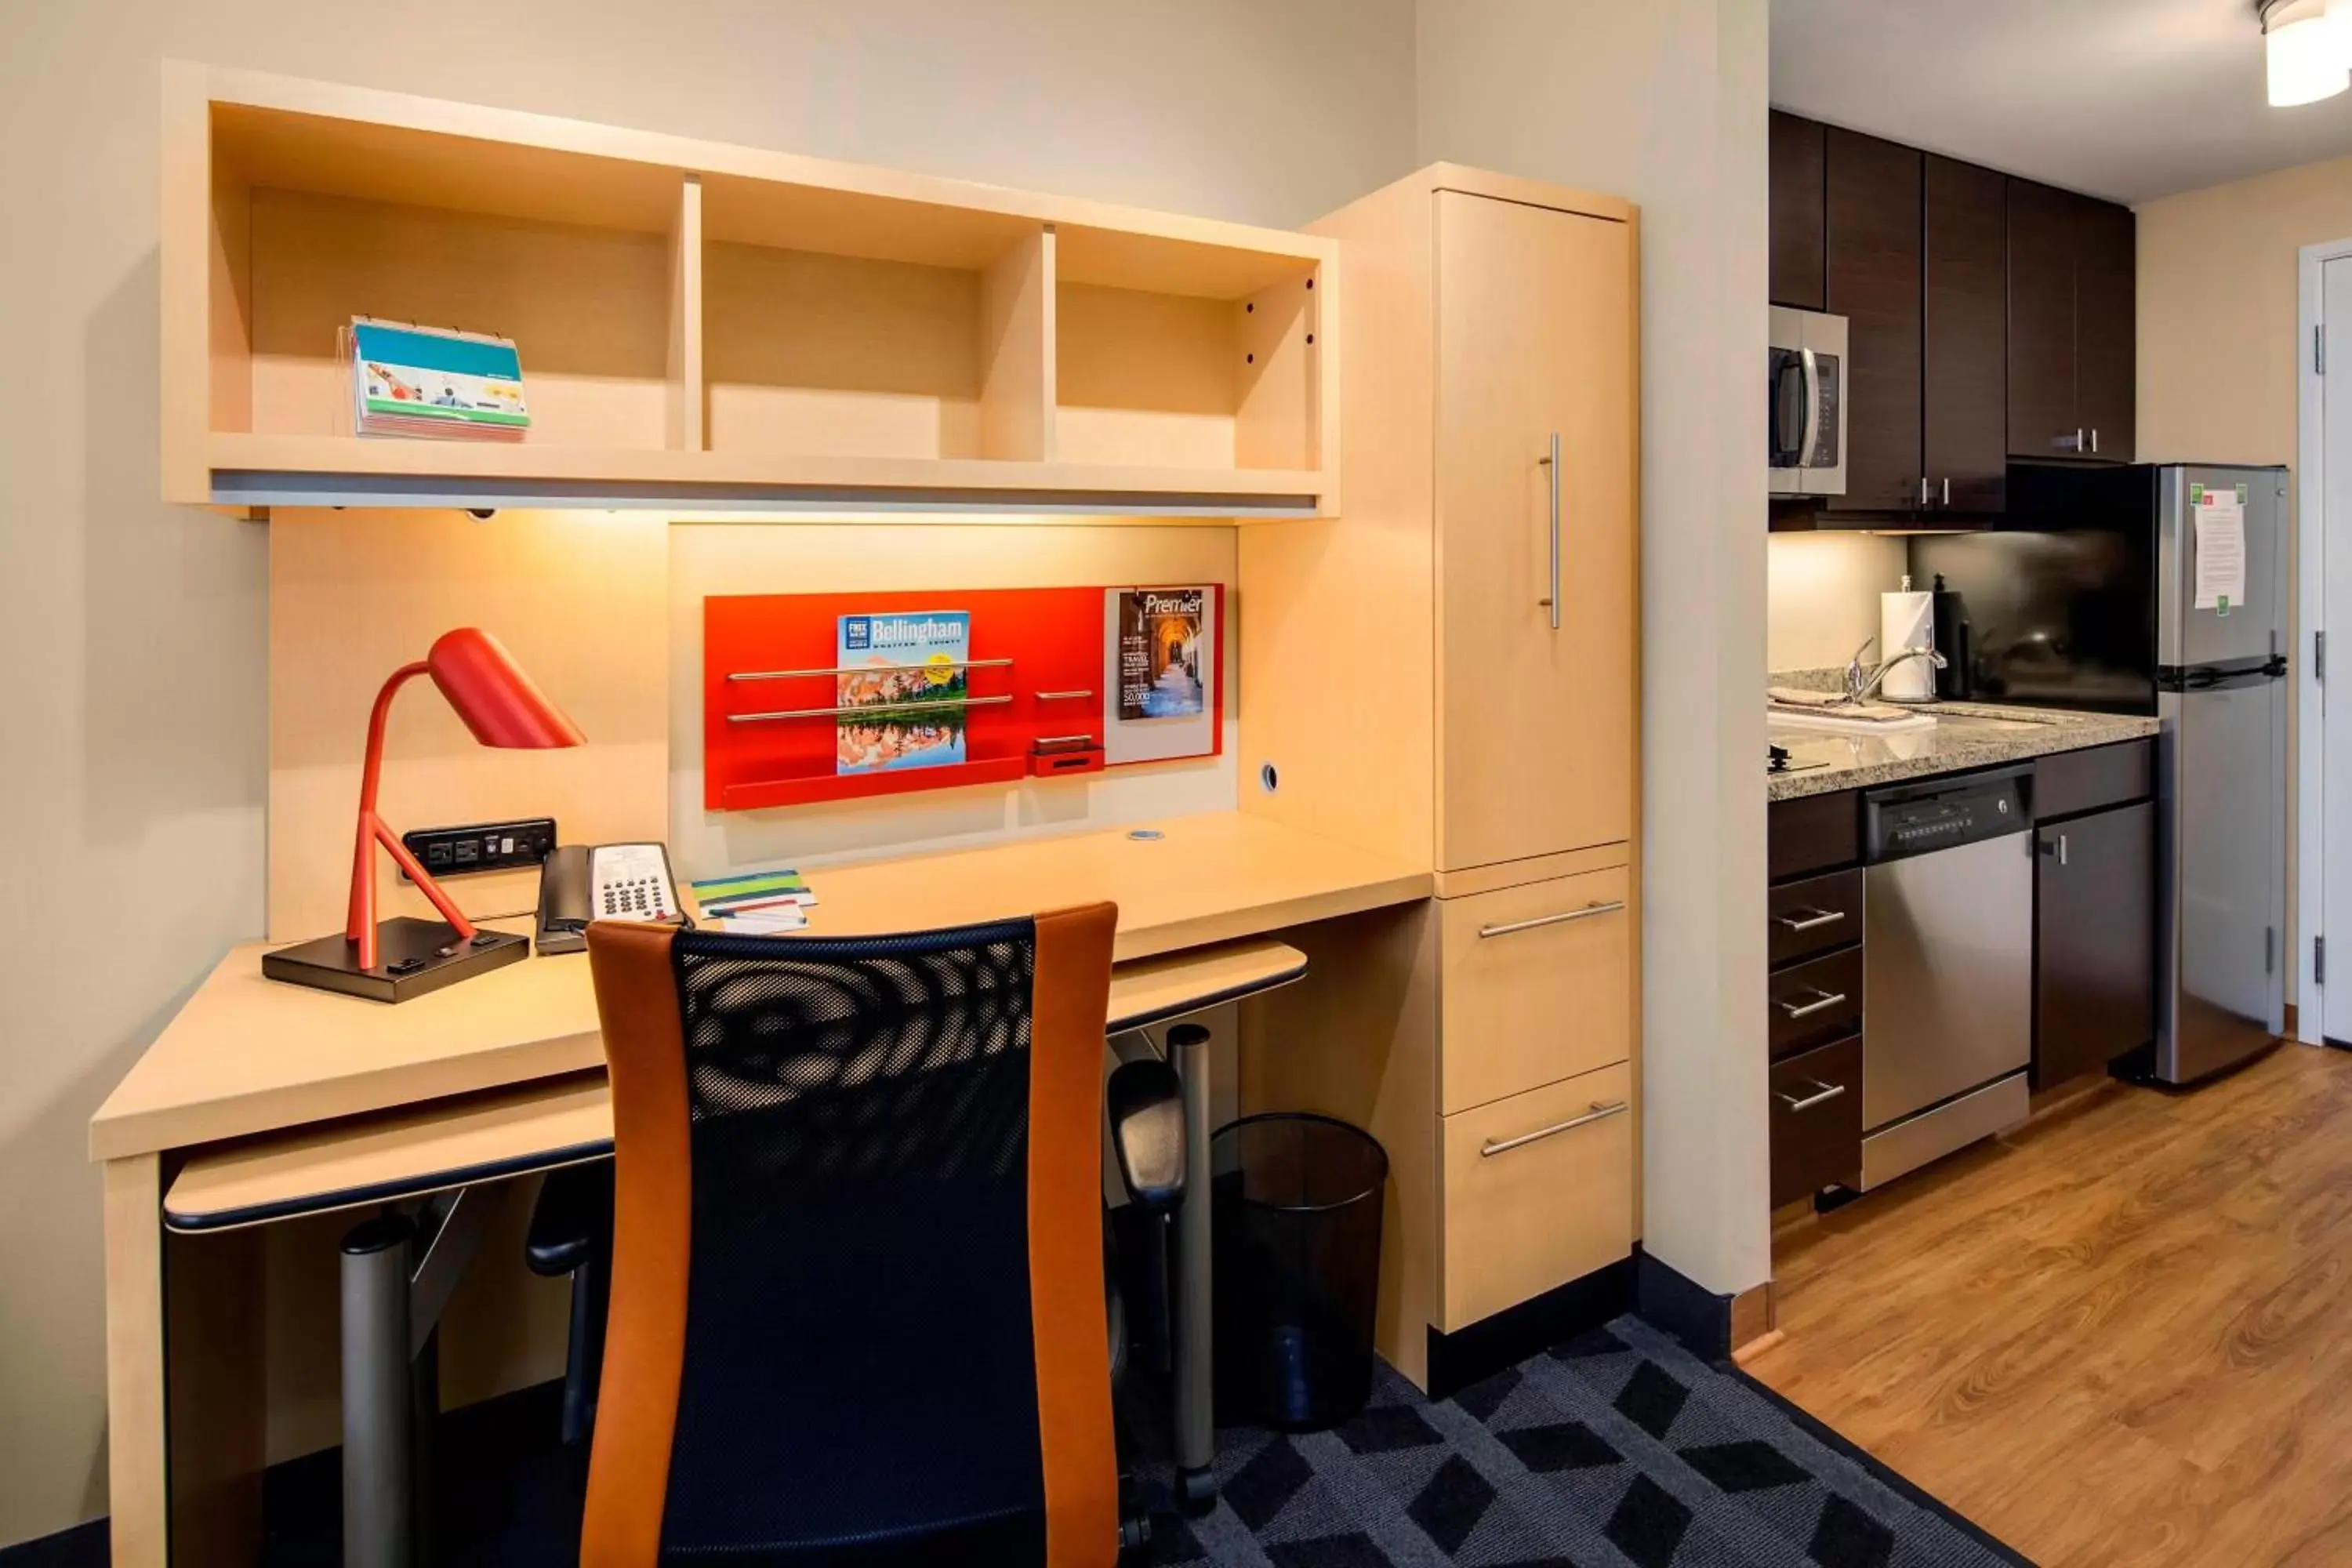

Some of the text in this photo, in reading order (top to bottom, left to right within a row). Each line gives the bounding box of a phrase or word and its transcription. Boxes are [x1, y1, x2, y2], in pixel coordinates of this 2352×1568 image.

[1144, 593, 1203, 613] Premier
[873, 618, 962, 642] Bellingham
[1123, 692, 1150, 702] 50,000
